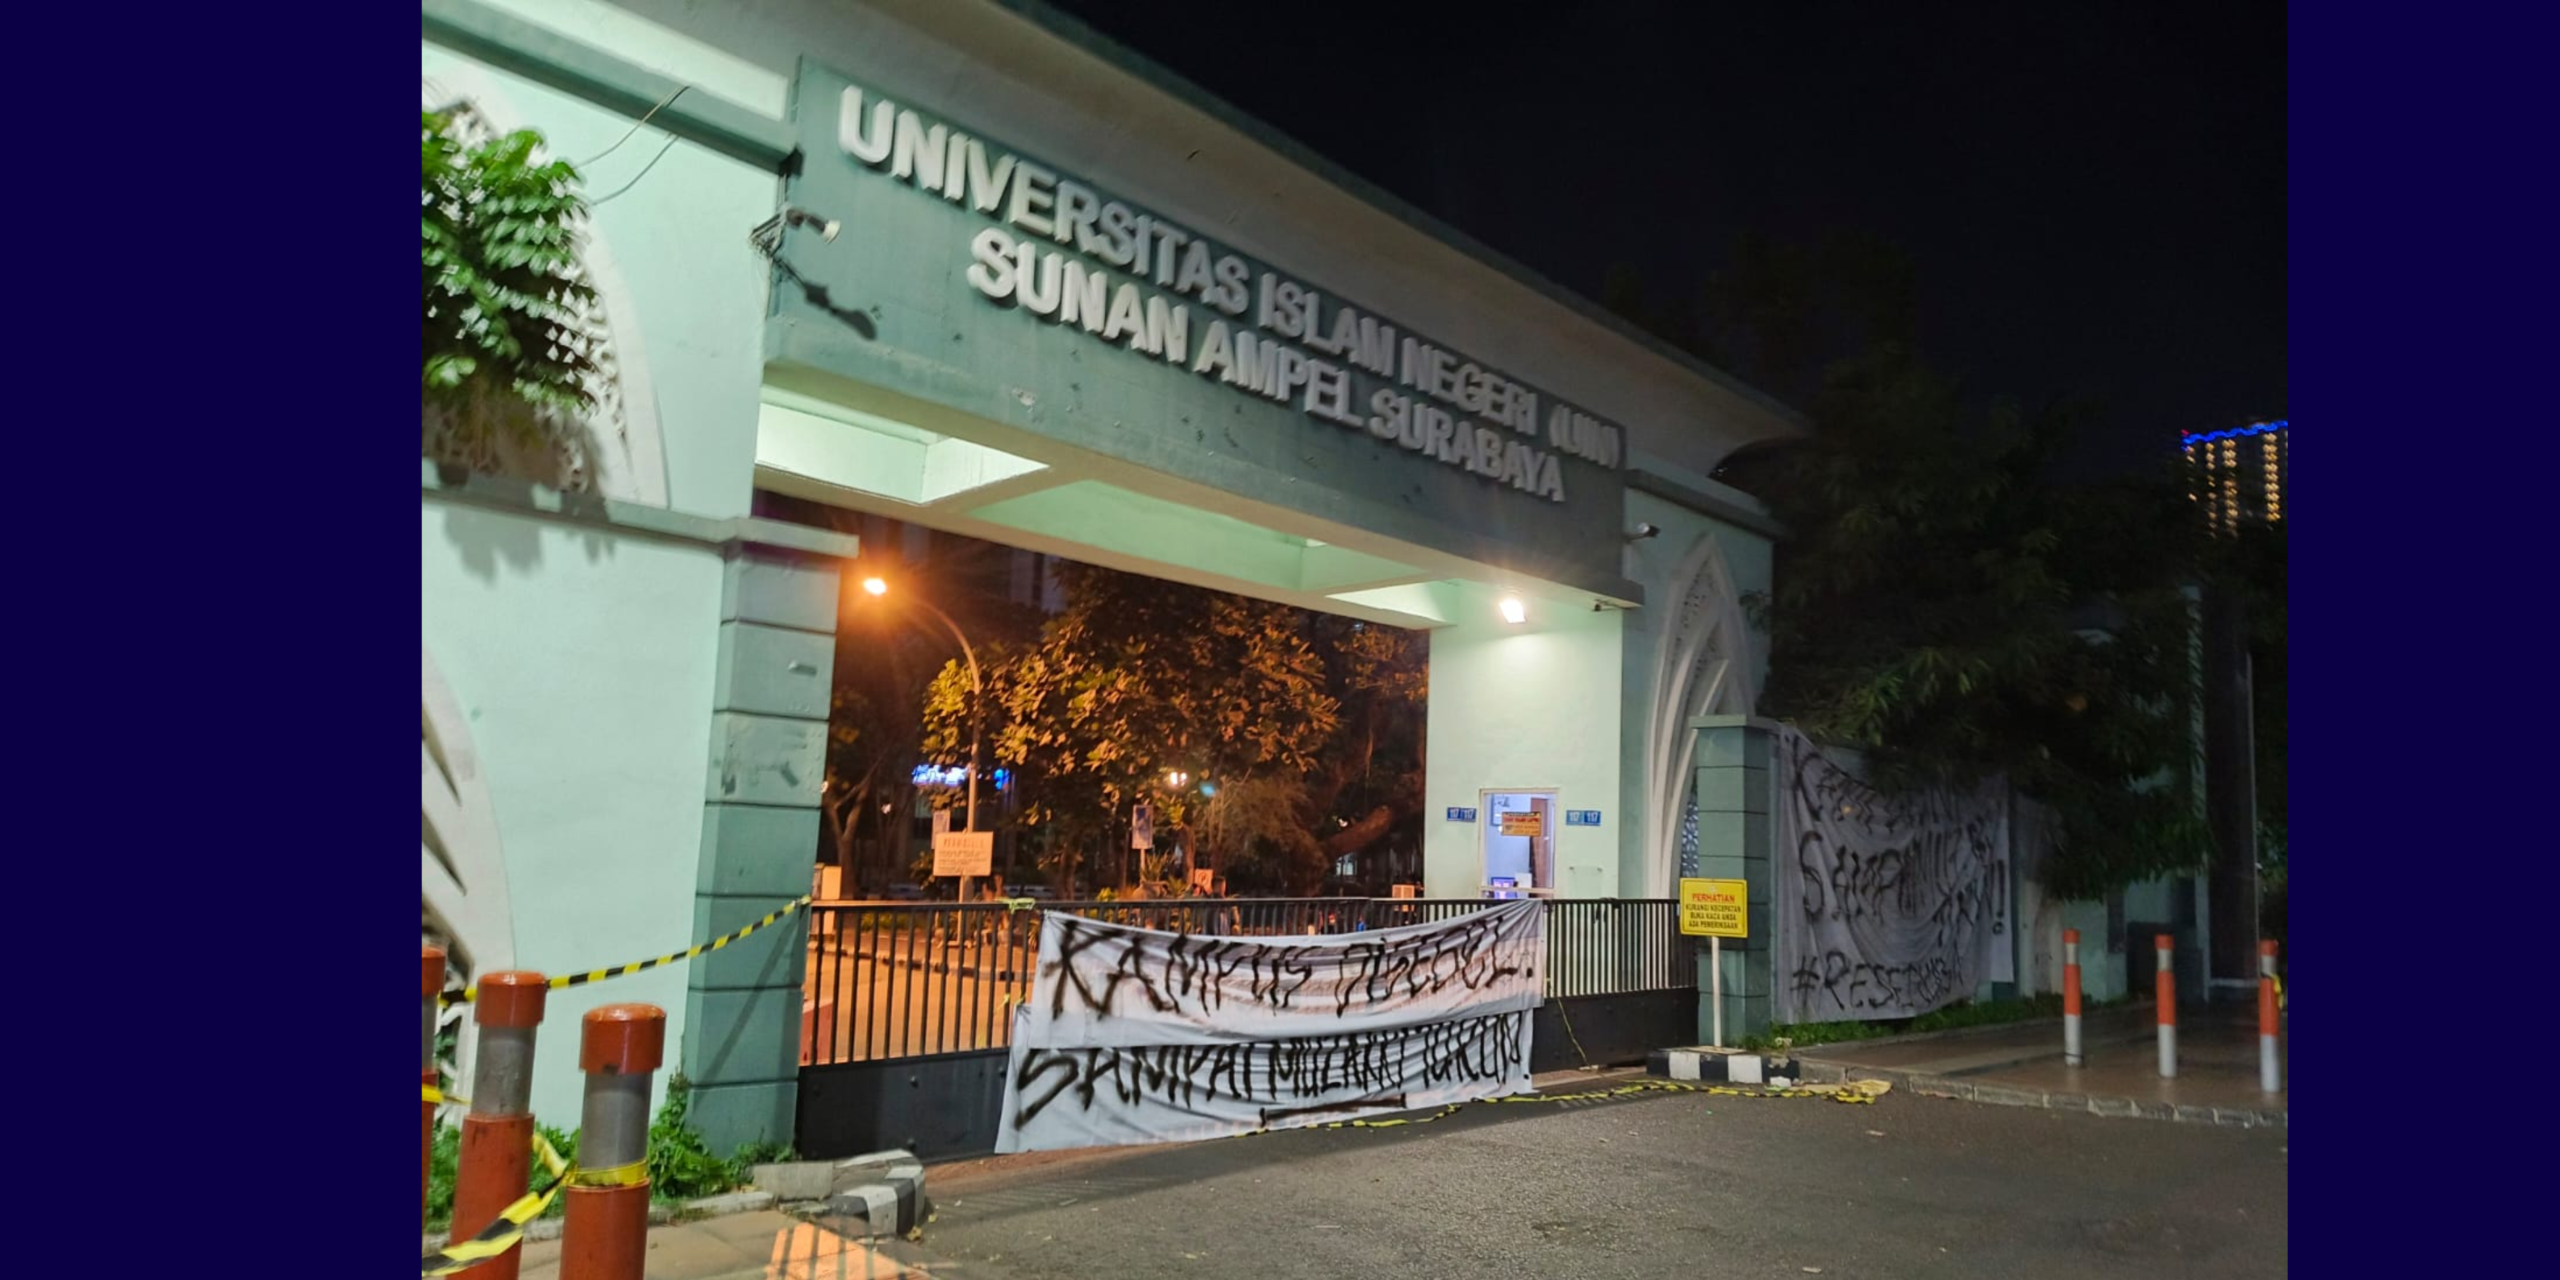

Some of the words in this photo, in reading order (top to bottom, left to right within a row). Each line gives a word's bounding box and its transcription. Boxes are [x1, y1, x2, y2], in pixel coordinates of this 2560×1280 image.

[838, 84, 1250, 315] UNIVERSITAS
[1259, 272, 1396, 377] ISLAM
[1402, 337, 1538, 436] NEGERI
[1549, 404, 1620, 469] (UIN)
[967, 227, 1190, 363] SUNAN
[1193, 320, 1363, 428] AMPEL
[1368, 388, 1565, 501] SURABAYA
[1692, 893, 1735, 903] PERHATIAN
[1706, 912, 1721, 920] KACA
[1722, 913, 1736, 921] ANDA
[1711, 904, 1741, 913] KECEPATAN
[1700, 921, 1738, 929] PEMERIKSAAN
[1042, 919, 1316, 1019] KAMPUS
[1013, 1043, 1253, 1129] SAMPAI
